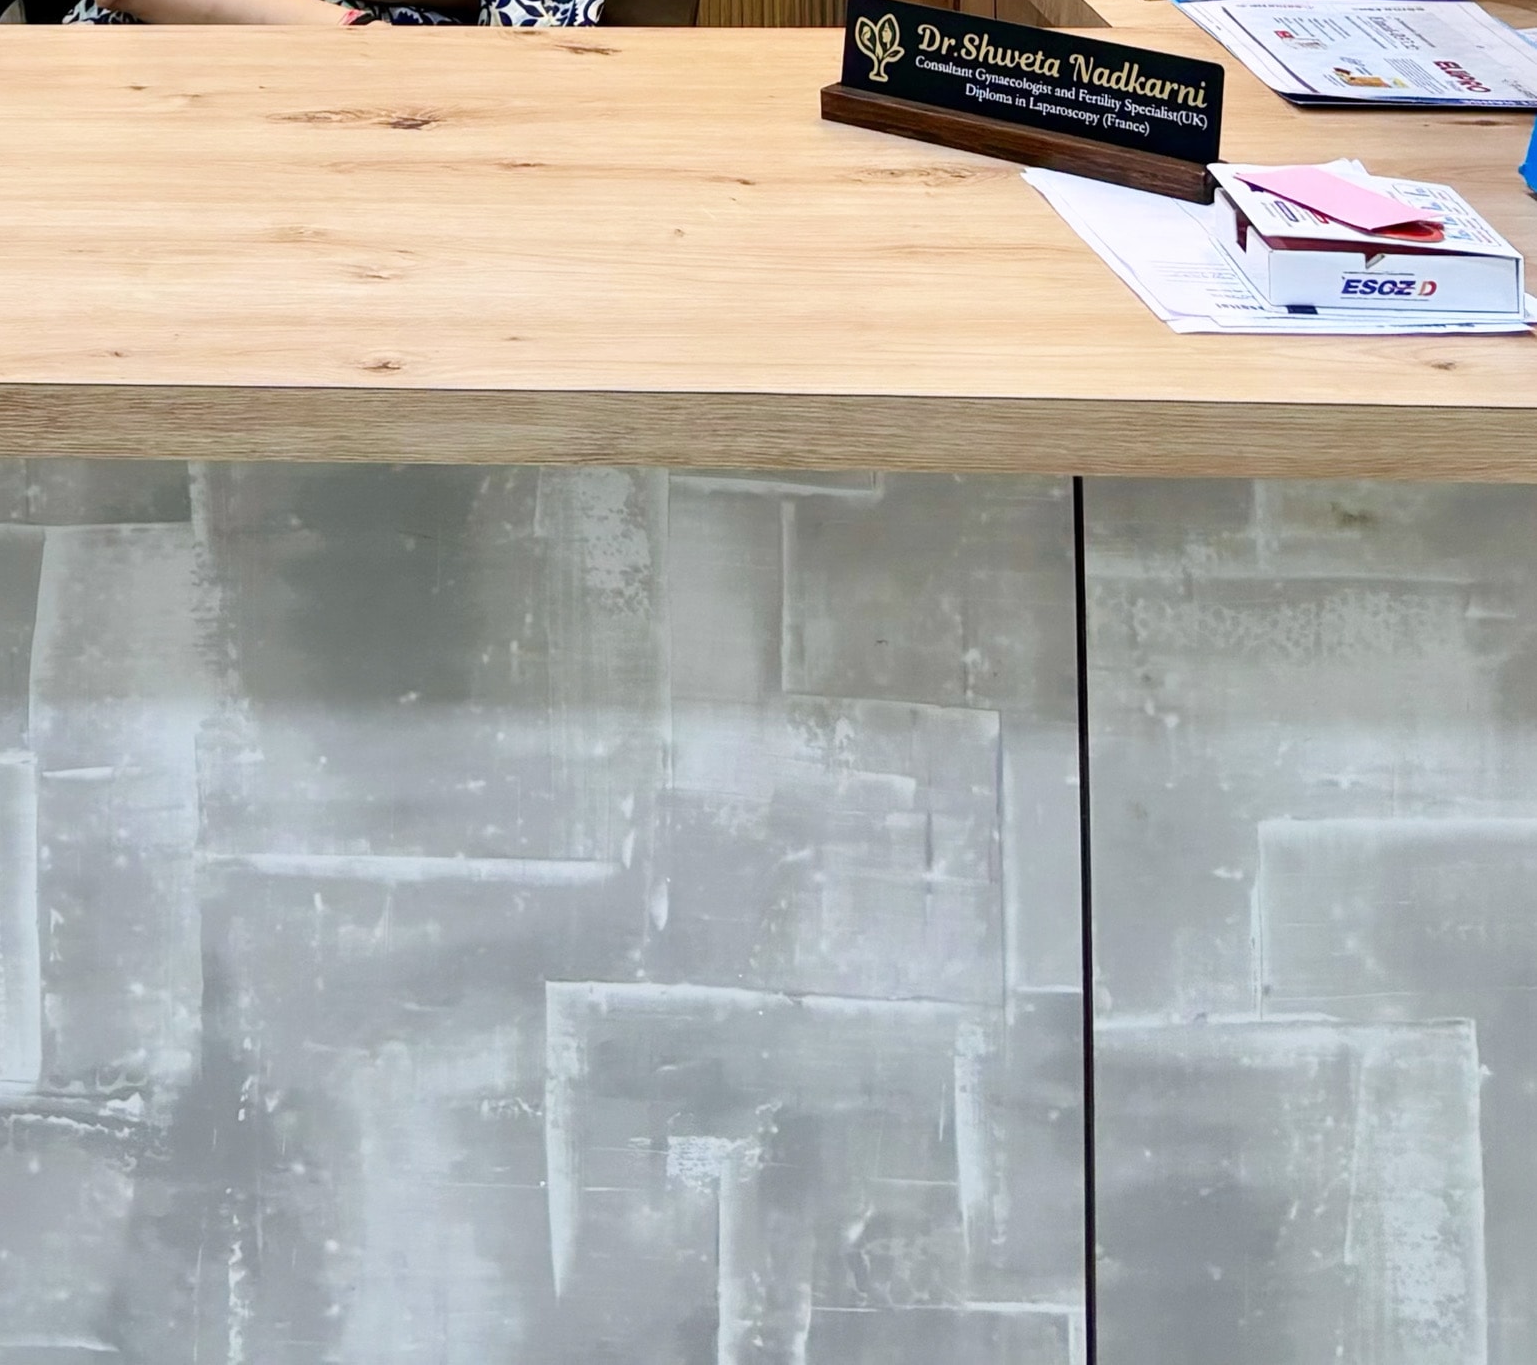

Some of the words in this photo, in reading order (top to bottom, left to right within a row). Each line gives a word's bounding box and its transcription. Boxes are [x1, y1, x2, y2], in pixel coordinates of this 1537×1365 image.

[915, 56, 973, 78] Consultant
[975, 69, 1052, 95] Gynaecologist
[1055, 86, 1075, 100] and
[1079, 90, 1122, 112] Fertility
[1124, 100, 1208, 130] Specialist(UK)
[1069, 53, 1208, 108] Nadkarni
[965, 84, 1013, 104] Diploma
[1015, 94, 1026, 106] in
[1029, 98, 1099, 126] Laparoscopy
[1103, 113, 1150, 136] (France)
[1341, 278, 1416, 296] ESOZ
[1418, 280, 1437, 296] D
